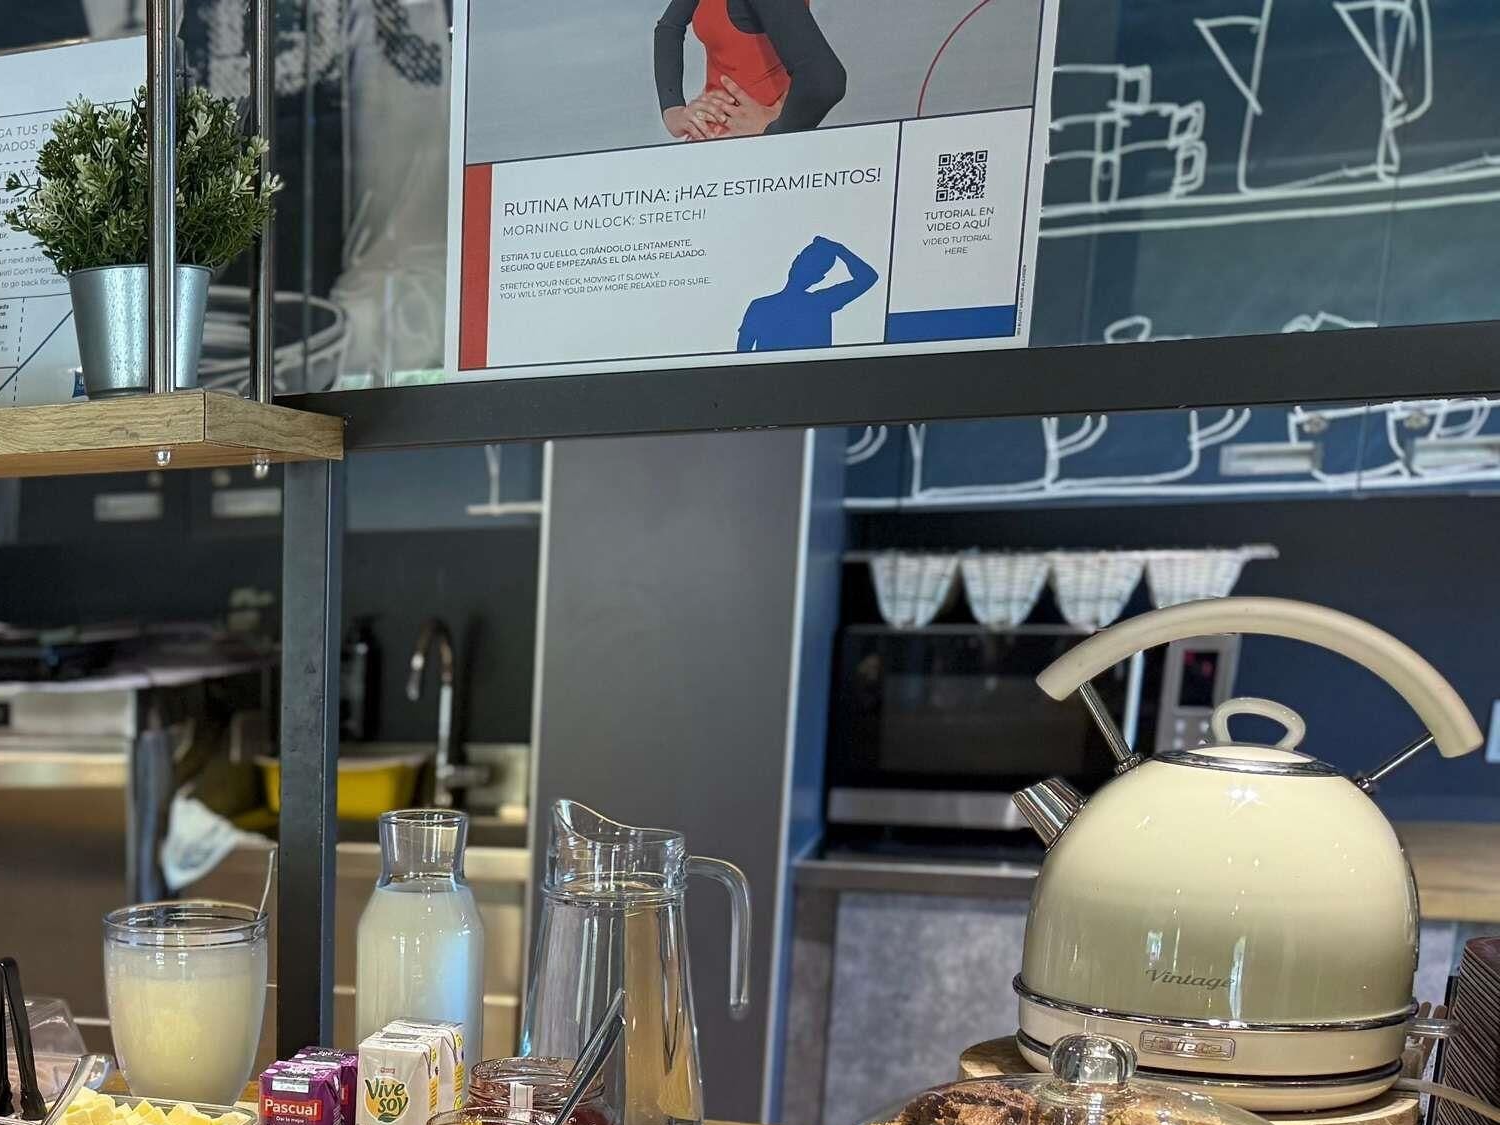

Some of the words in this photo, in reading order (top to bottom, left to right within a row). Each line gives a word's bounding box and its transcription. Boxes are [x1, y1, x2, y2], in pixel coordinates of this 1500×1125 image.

[17, 125, 38, 136] TUS
[504, 198, 568, 216] RUTINA
[574, 188, 671, 210] MATUTINA:
[675, 183, 718, 204] ¡HAZ
[724, 168, 881, 197] ESTIRAMIENTOS!
[924, 209, 976, 220] TUTORIAL
[979, 207, 995, 216] EN
[503, 221, 569, 237] MORNING
[573, 216, 635, 231] UNLOCK:
[639, 209, 706, 225] STRETCH!
[927, 222, 960, 231] VIDEO
[963, 217, 990, 229] AQUÍ
[923, 237, 949, 246] VIDEO
[952, 234, 992, 243] TUTORIAL
[501, 253, 529, 262] ESTIRA
[531, 252, 541, 260] TU
[580, 244, 631, 255] GIRÁNDOLO
[944, 247, 968, 255] HERE
[501, 263, 534, 273] SEGURO
[536, 261, 554, 270] QUE
[557, 257, 607, 268] EMPEZARÁS
[622, 254, 636, 263] DÍA
[639, 252, 657, 261] MÁS
[659, 249, 707, 260] RELAJADO.
[21, 279, 38, 287] back
[500, 281, 533, 291] STRETCH
[535, 279, 557, 288] YOUR
[500, 291, 516, 299] YOU
[518, 290, 536, 298] WILL
[538, 288, 560, 297] START
[563, 287, 584, 295] YOUR
[587, 285, 602, 293] DAY
[605, 283, 628, 291] MORE
[631, 281, 666, 290] RELAXED
[669, 279, 686, 287] FOR
[1146, 968, 1236, 990] Vintage
[365, 1077, 406, 1100] Vive
[265, 1098, 318, 1116] Pascual
[377, 1096, 409, 1117] soy
